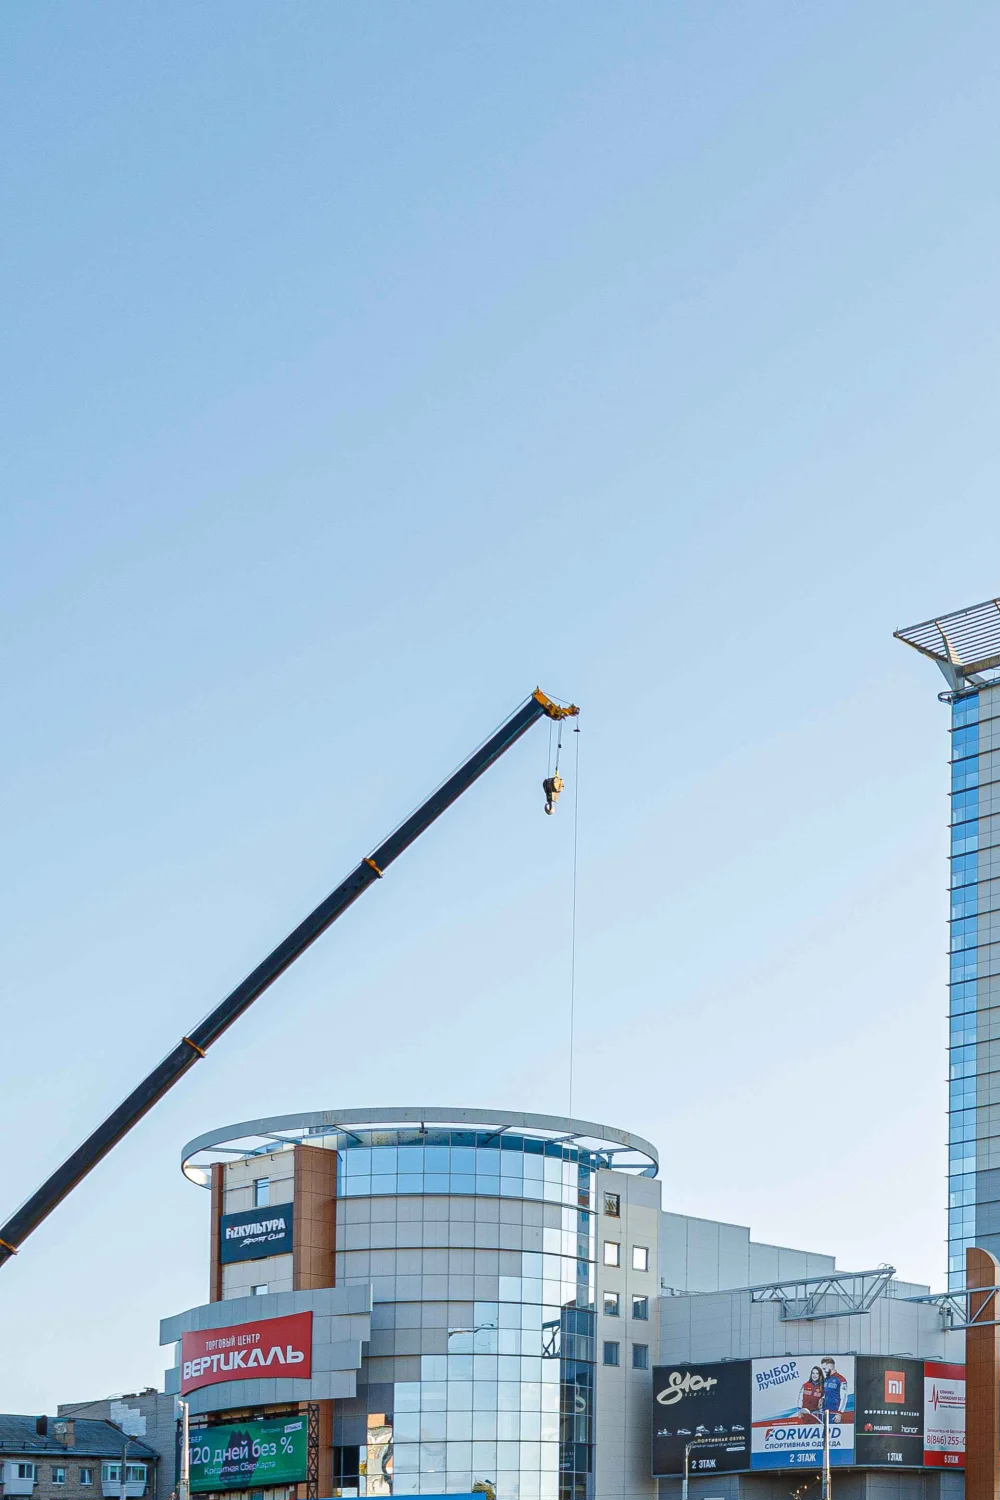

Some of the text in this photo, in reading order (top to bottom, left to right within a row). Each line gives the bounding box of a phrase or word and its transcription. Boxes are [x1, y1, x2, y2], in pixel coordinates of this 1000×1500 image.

[205, 1333, 260, 1351] ТОРГОВЫЙ ЦЕНТР
[183, 1345, 305, 1380] ВЕРТИКАЛЬ
[755, 1361, 797, 1383] ВЫБОР
[758, 1370, 800, 1391] ЛУЧШИХ!
[765, 1427, 842, 1441] FORWAD
[927, 1435, 946, 1446] 8(846)
[189, 1436, 294, 1466] 120 дней без %
[765, 1441, 810, 1449] СПОРТИВНАЯ
[691, 1459, 716, 1469] 2 ЭТАЖ
[789, 1453, 816, 1463] 2 ЭТАЖ
[204, 1461, 276, 1475] Кредитная СберКарта
